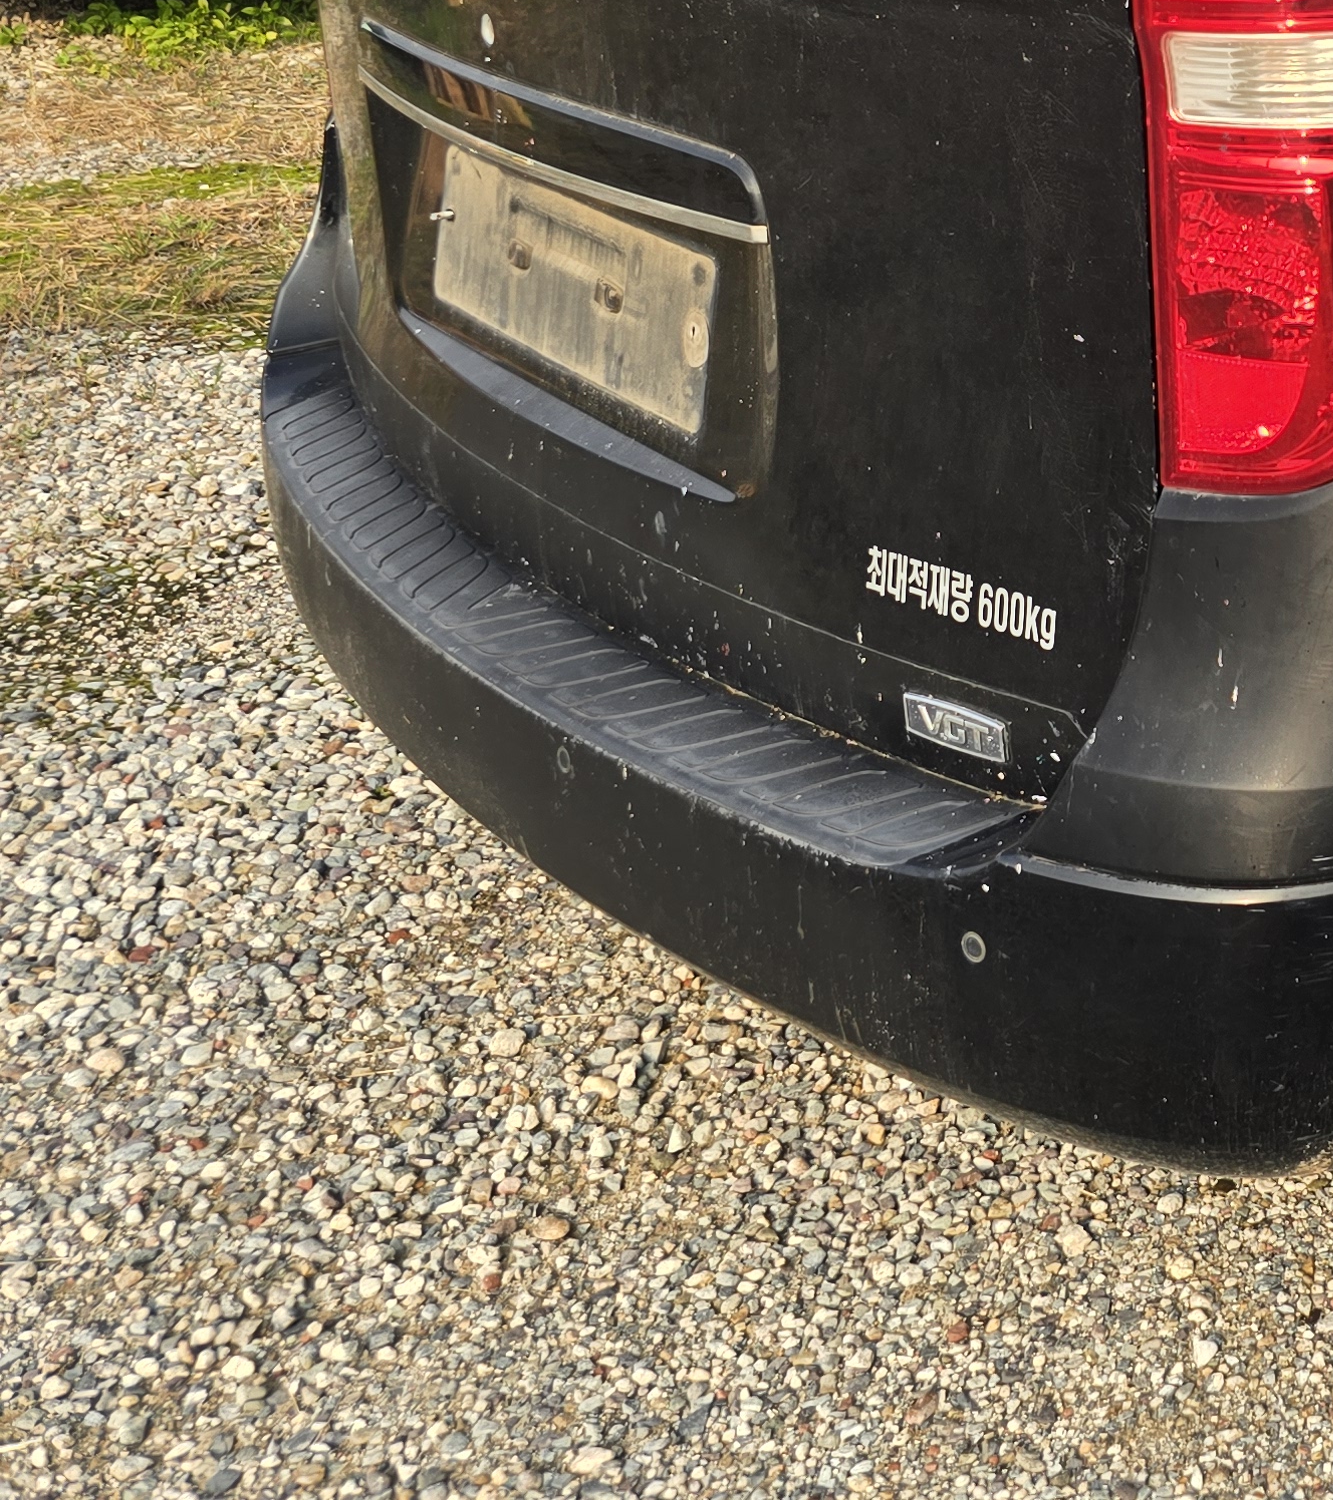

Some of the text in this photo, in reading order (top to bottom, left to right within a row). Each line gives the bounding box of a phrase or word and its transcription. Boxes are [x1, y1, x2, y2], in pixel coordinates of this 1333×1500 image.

[865, 545, 1056, 650] 최대적재량 600kg
[917, 704, 989, 751] VGT
